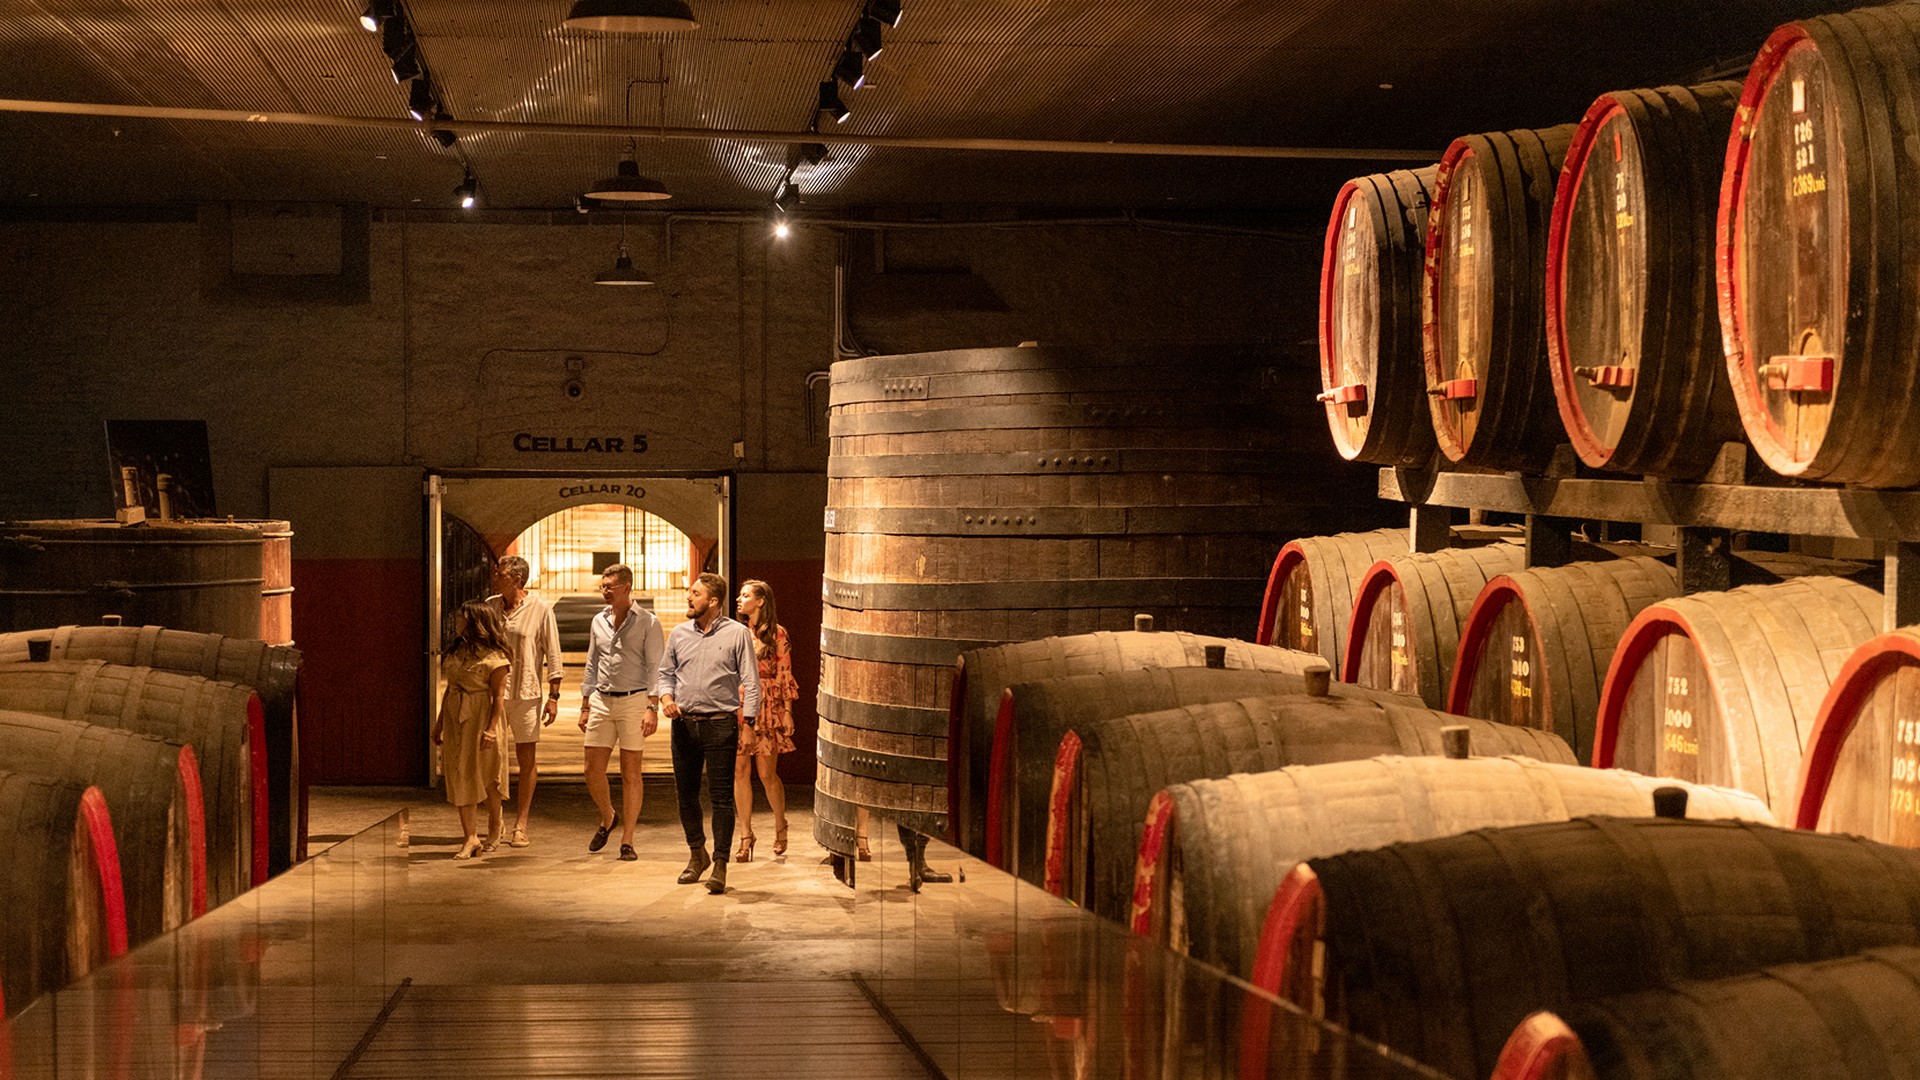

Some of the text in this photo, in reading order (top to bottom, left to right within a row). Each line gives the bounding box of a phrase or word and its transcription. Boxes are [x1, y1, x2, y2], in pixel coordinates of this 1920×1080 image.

[513, 433, 649, 453] CELLAR 5
[559, 484, 647, 499] CELLAR 20
[1664, 707, 1692, 728] 1000
